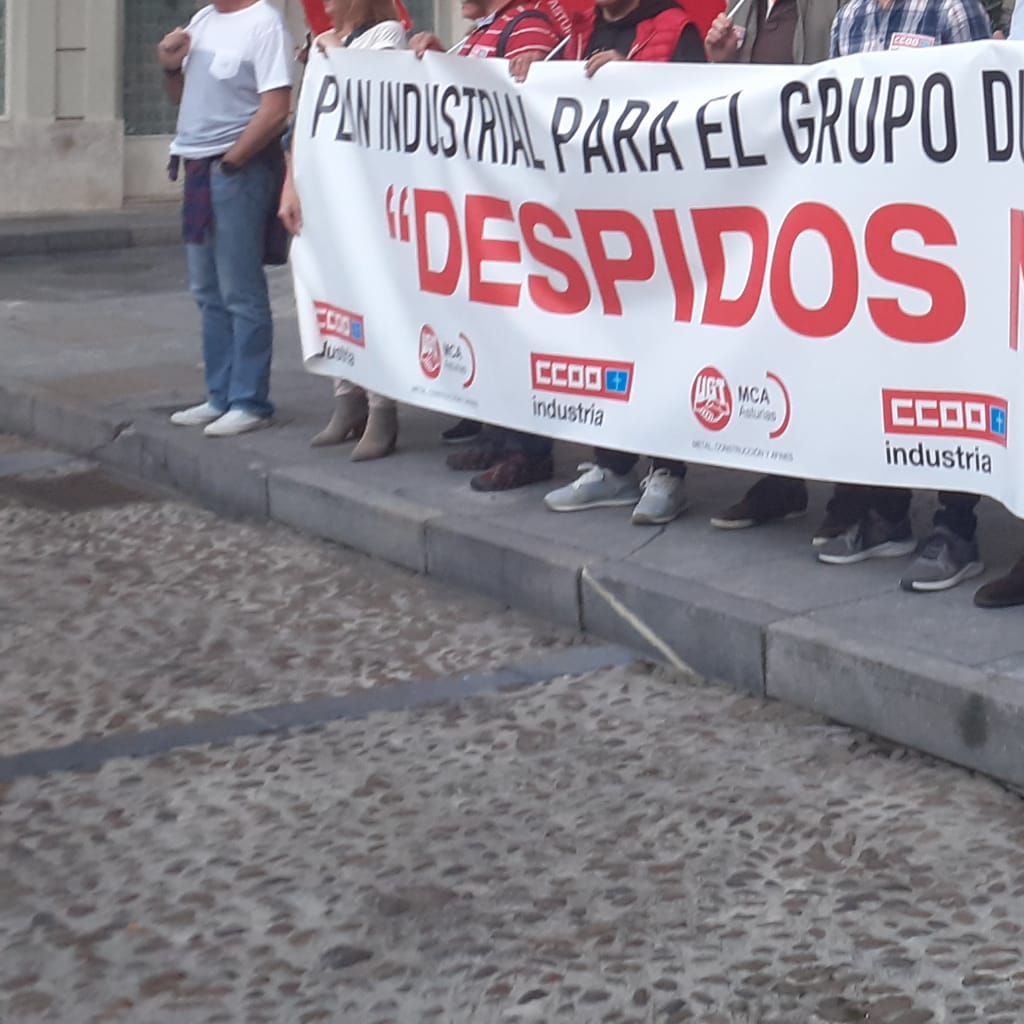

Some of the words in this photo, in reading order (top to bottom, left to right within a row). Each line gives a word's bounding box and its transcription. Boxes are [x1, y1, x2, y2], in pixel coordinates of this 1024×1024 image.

[379, 80, 546, 171] INDUSTRIAL
[551, 96, 683, 174] PARA
[696, 88, 768, 170] EL
[780, 72, 958, 164] GRUPO
[535, 359, 602, 391] CCOO
[531, 395, 605, 427] industria
[738, 384, 770, 405] MCA
[891, 397, 987, 432] CCOO
[884, 439, 992, 475] industria
